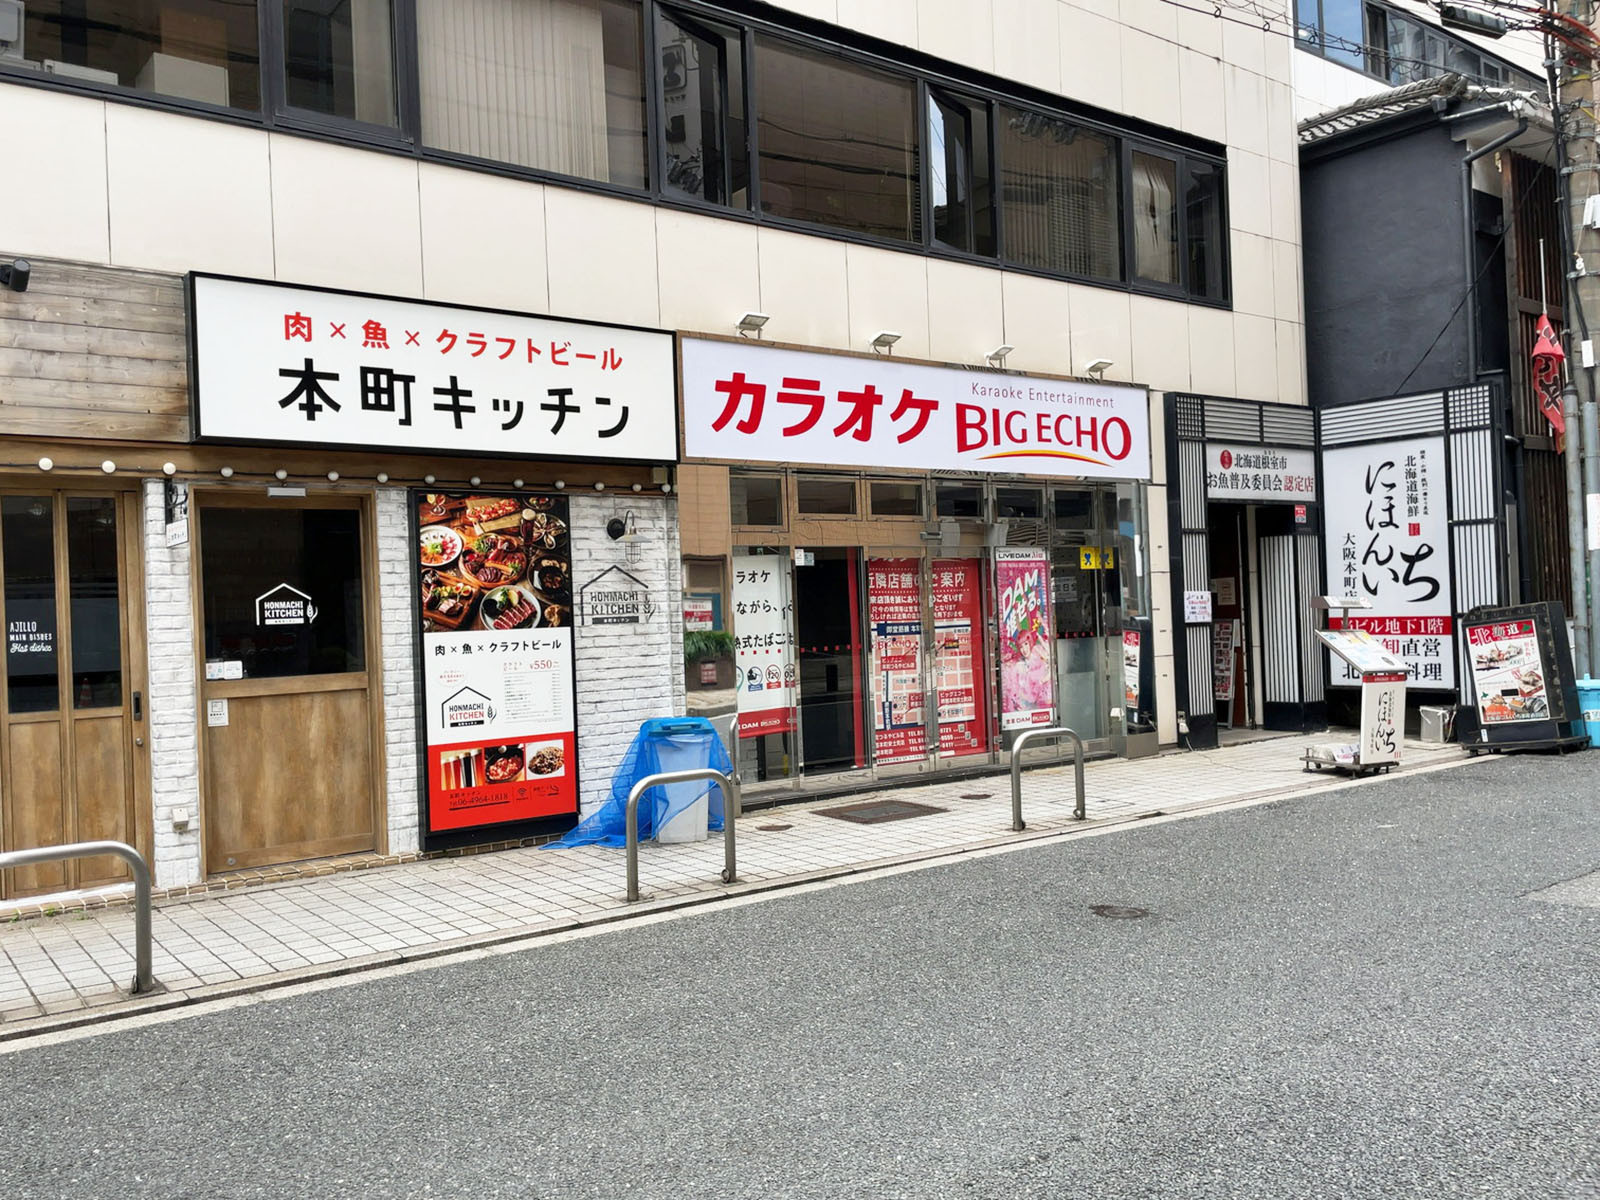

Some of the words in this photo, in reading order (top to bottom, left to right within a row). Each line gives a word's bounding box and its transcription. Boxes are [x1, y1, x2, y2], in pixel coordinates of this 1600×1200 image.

[278, 358, 629, 439] 本町キッチン
[971, 382, 1023, 400] Karaoke
[1028, 387, 1115, 409] Entertainment
[711, 372, 939, 444] カラオケ
[956, 402, 1027, 454] BIG
[1036, 413, 1132, 460] ECHO
[1234, 453, 1288, 470] 北海道根室市
[1404, 455, 1420, 517] 北海道海鮮
[736, 570, 771, 584] ラオケ
[590, 591, 638, 602] HONMACHI
[1003, 568, 1038, 623] DAM
[264, 601, 303, 609] HONMACHI
[591, 604, 639, 615] KITCHEN
[264, 609, 304, 618] KITCHEN
[9, 621, 37, 633] AJILLO
[9, 633, 27, 641] MAIN
[1471, 623, 1520, 646] 北海道
[449, 703, 484, 712] HONMACHI
[449, 712, 485, 721] KITCHEN
